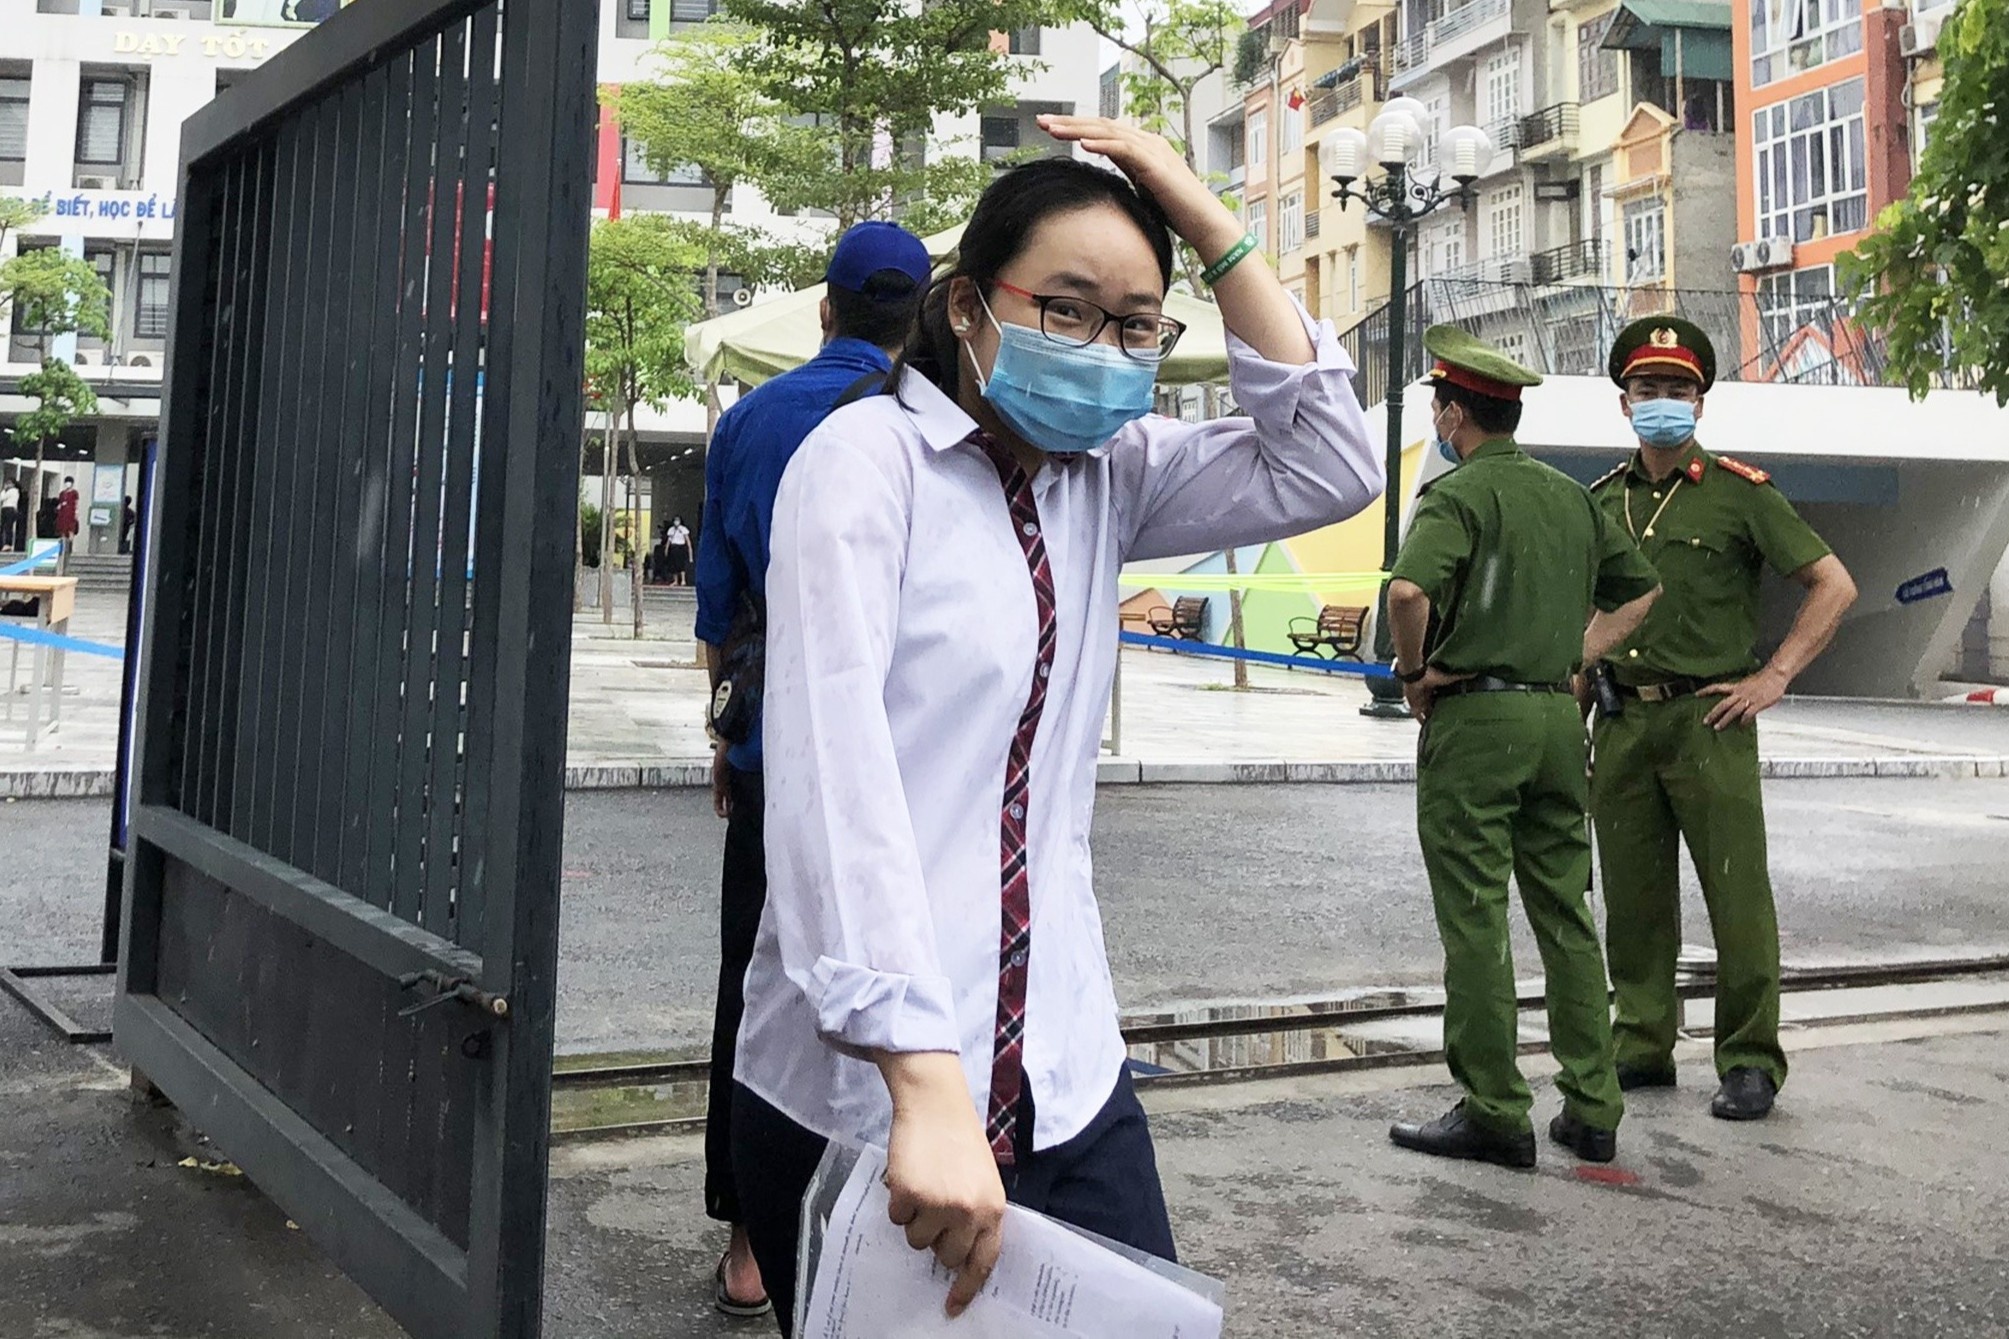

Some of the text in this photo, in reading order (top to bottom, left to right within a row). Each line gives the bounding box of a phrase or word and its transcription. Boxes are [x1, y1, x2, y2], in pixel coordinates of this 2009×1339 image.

[113, 28, 269, 60] DẠY TỐT
[56, 193, 94, 219] BIẾT,
[99, 200, 131, 220] HỌC
[136, 193, 157, 218] ĐỂ
